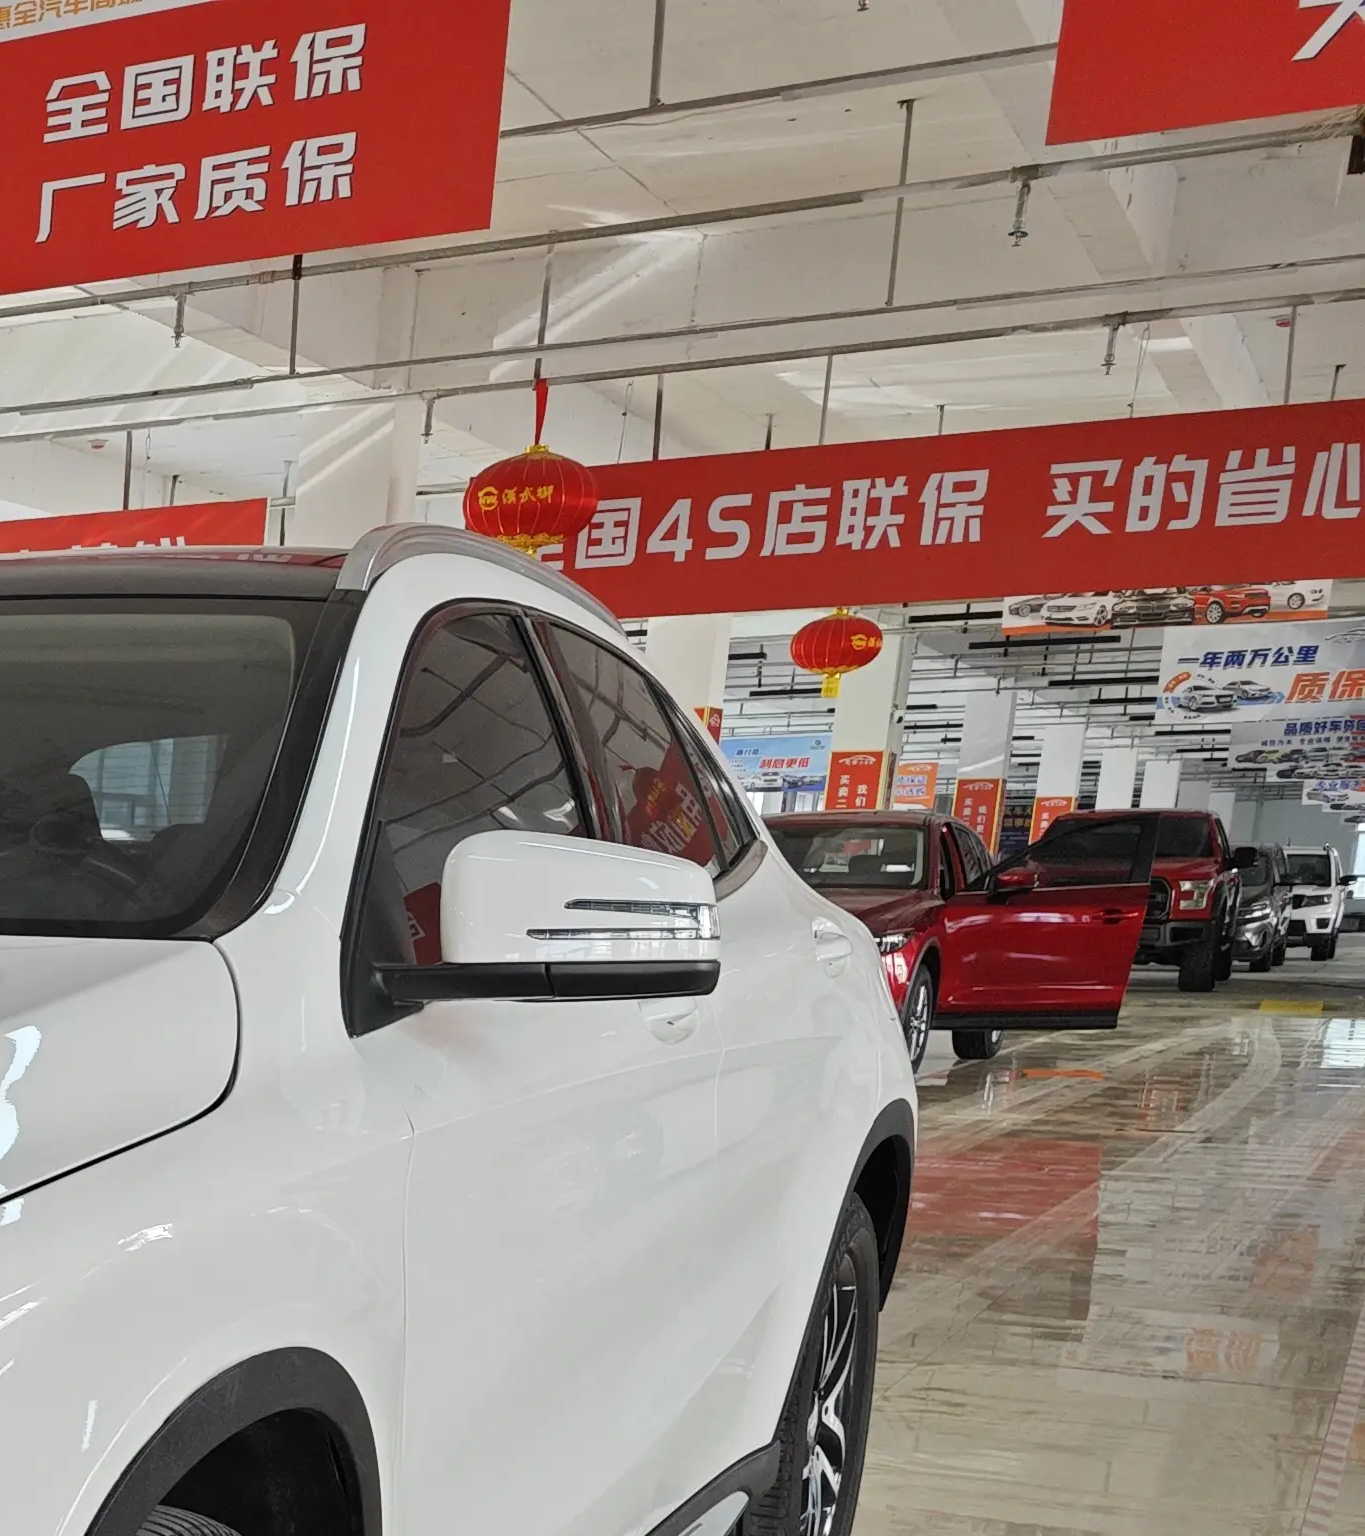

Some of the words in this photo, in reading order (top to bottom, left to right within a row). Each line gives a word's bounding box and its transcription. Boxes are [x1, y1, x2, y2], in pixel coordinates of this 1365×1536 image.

[43, 23, 367, 143] 全国联保
[35, 131, 358, 243] 厂家质保
[1041, 442, 1365, 538] 买的省心
[1177, 645, 1320, 670] 一年两万公里
[1285, 668, 1365, 705] 质保
